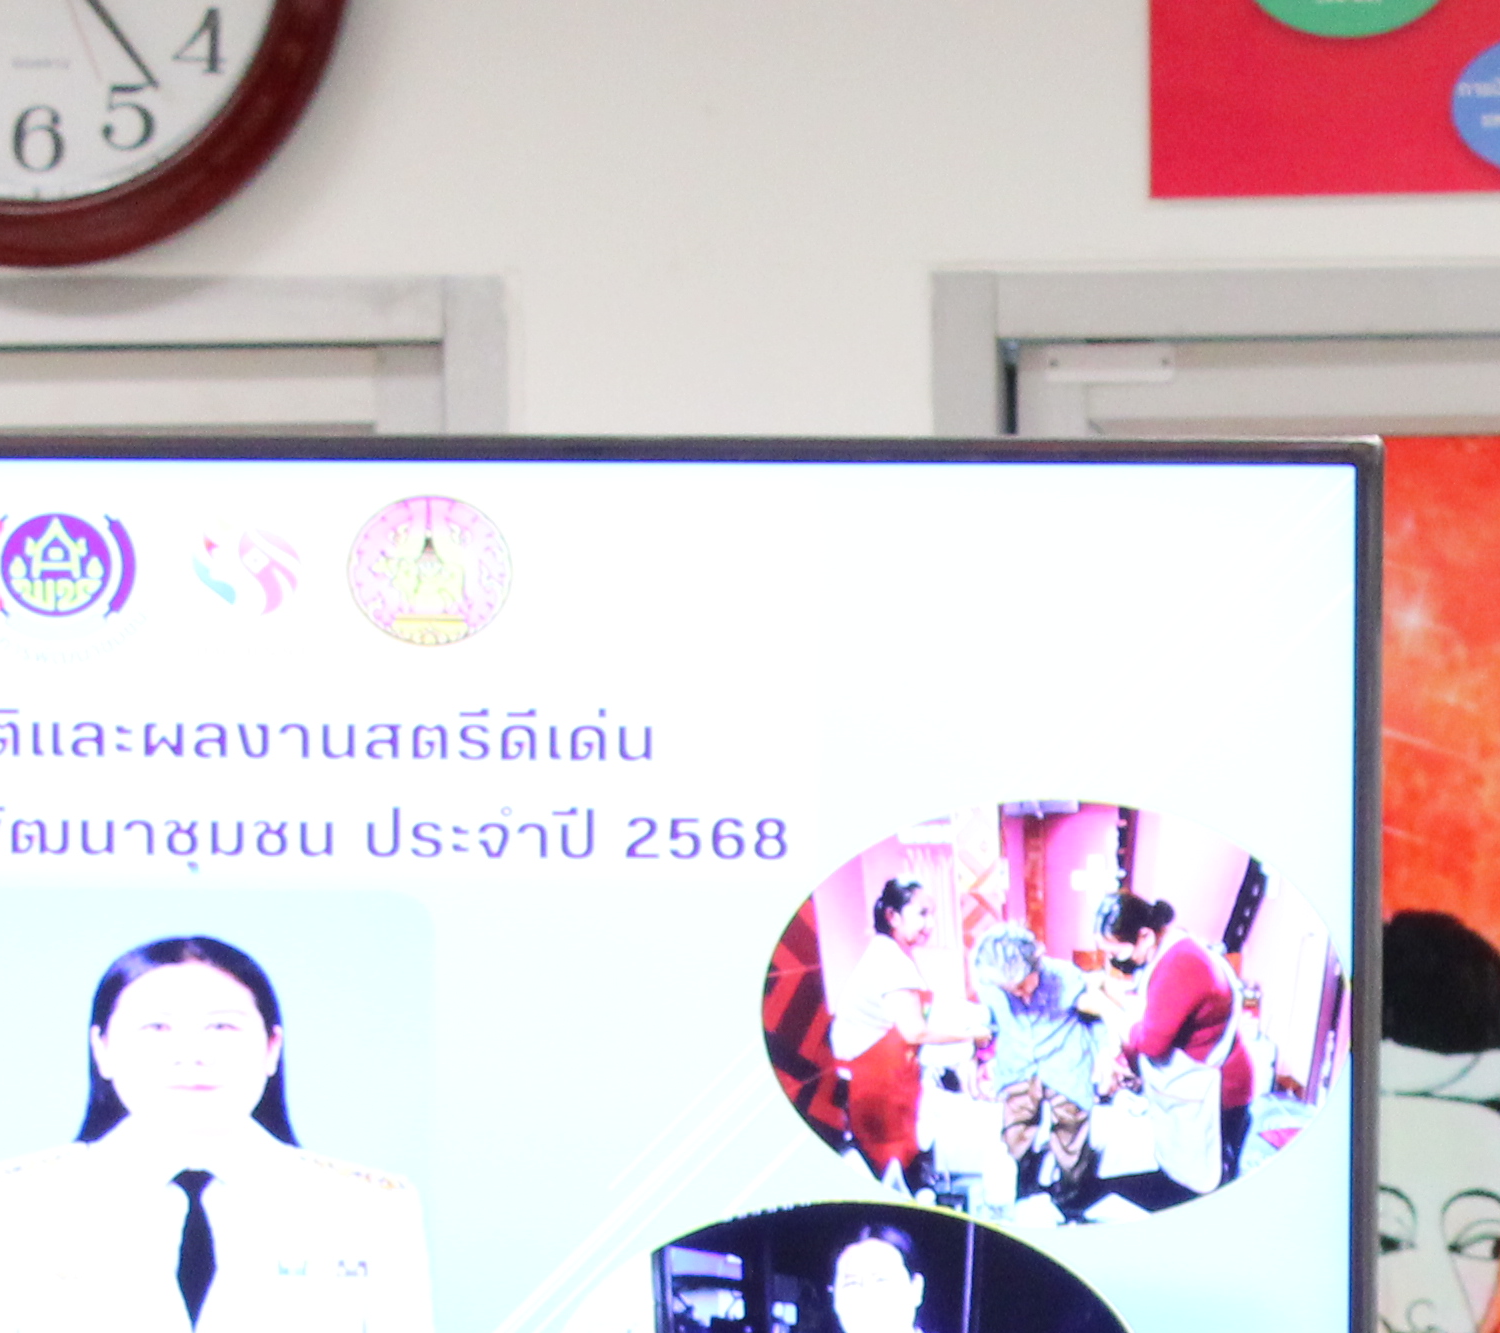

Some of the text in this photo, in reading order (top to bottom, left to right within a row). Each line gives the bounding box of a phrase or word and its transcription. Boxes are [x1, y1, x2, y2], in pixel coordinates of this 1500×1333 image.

[171, 6, 226, 75] 4
[12, 104, 66, 173] 6
[101, 80, 156, 152] 5
[365, 805, 596, 859] ประจำปี
[625, 817, 789, 860] 2568
